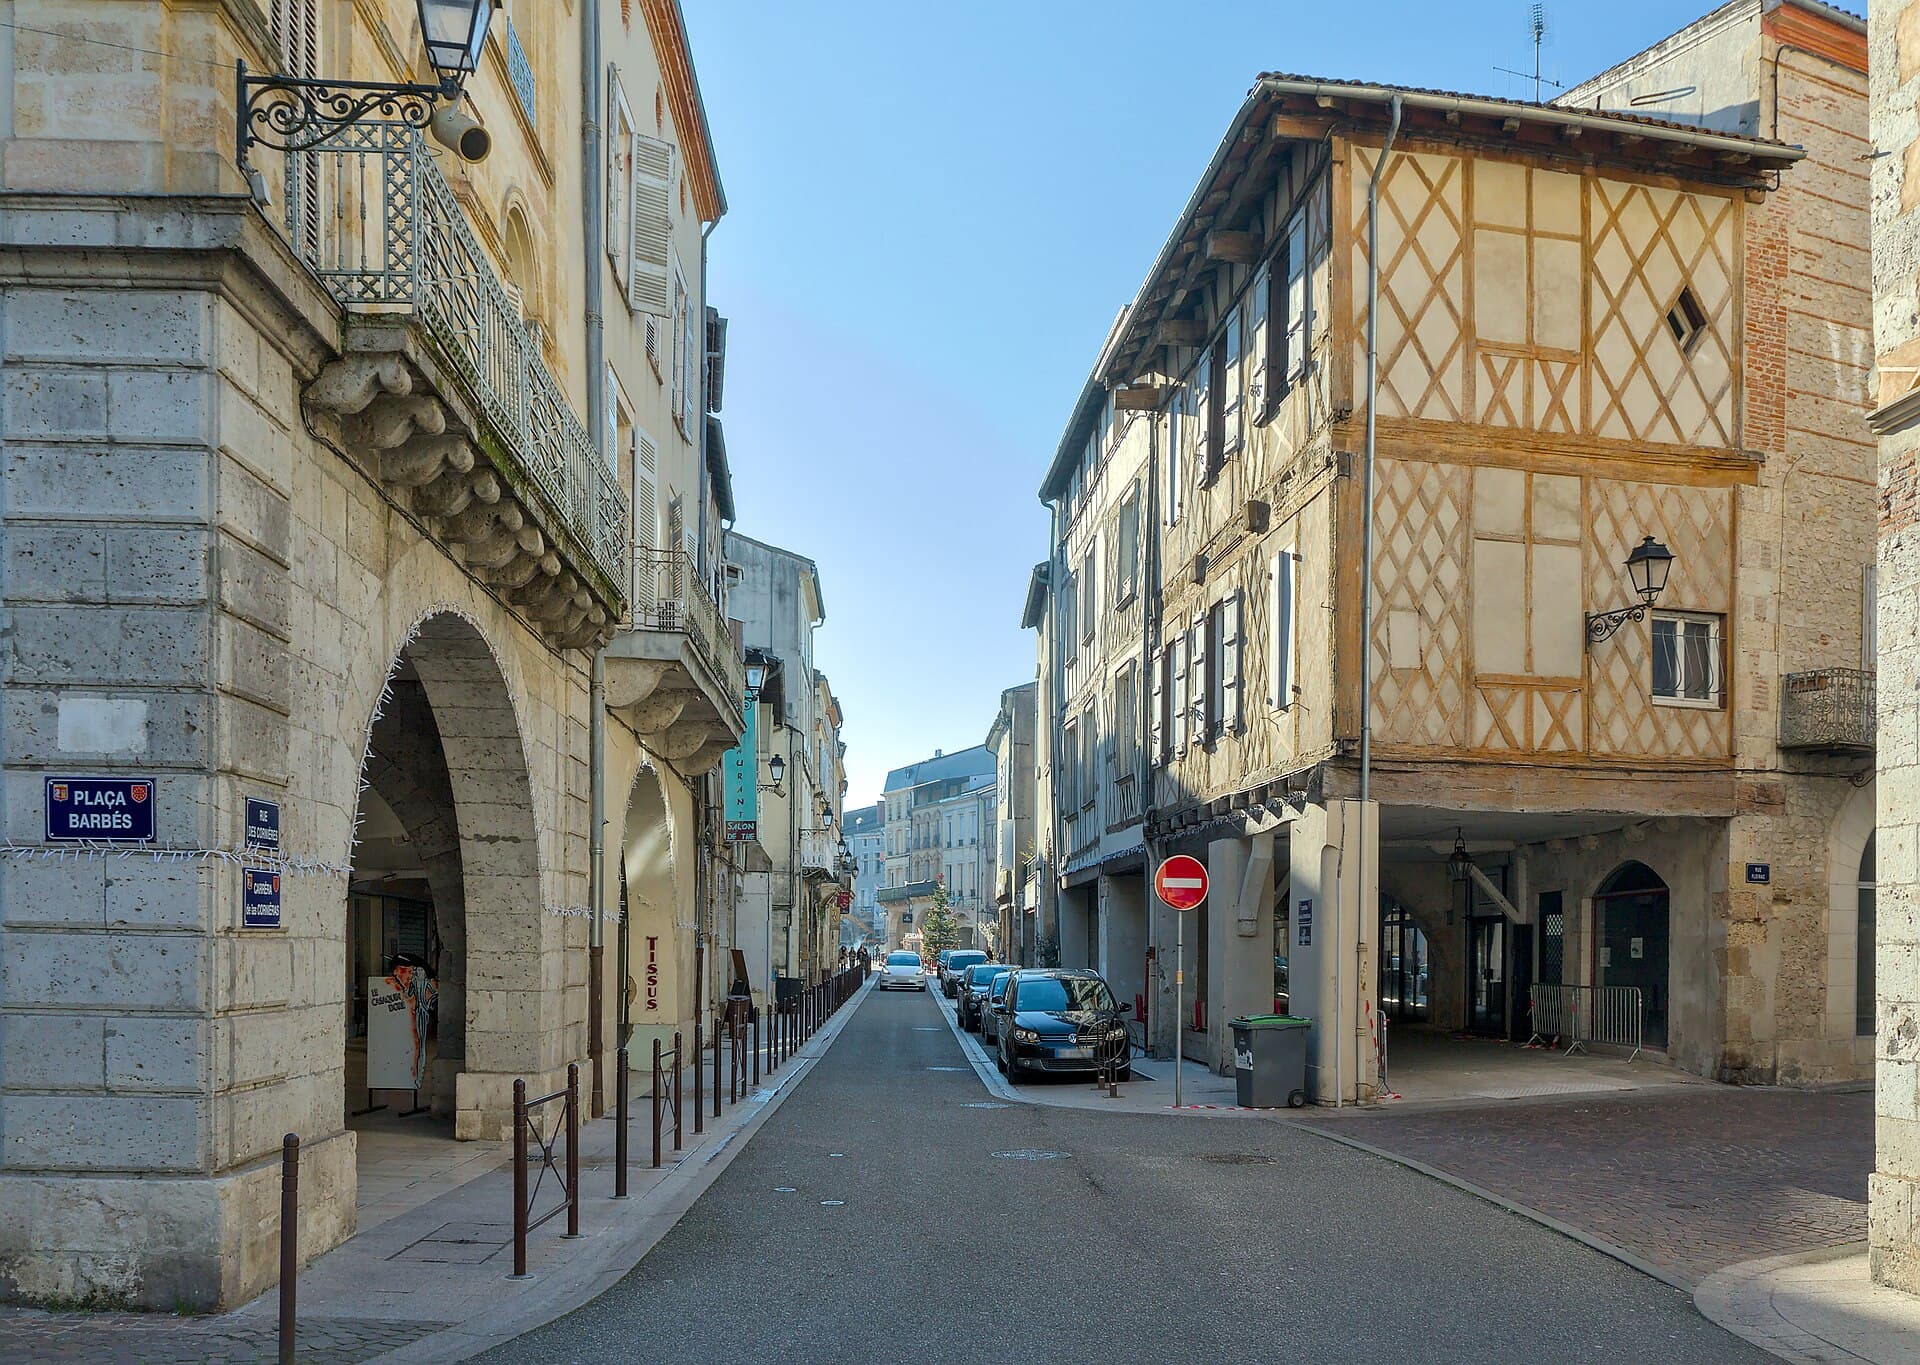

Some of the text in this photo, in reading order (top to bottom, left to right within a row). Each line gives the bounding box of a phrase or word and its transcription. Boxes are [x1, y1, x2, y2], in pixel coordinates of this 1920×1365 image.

[74, 790, 127, 810] PLAÇA
[68, 810, 133, 829] BARBÉS
[259, 809, 268, 822] RUE
[248, 825, 257, 838] DES
[727, 822, 755, 831] SALON
[646, 936, 659, 1011] TISSUS
[370, 988, 379, 998] LE
